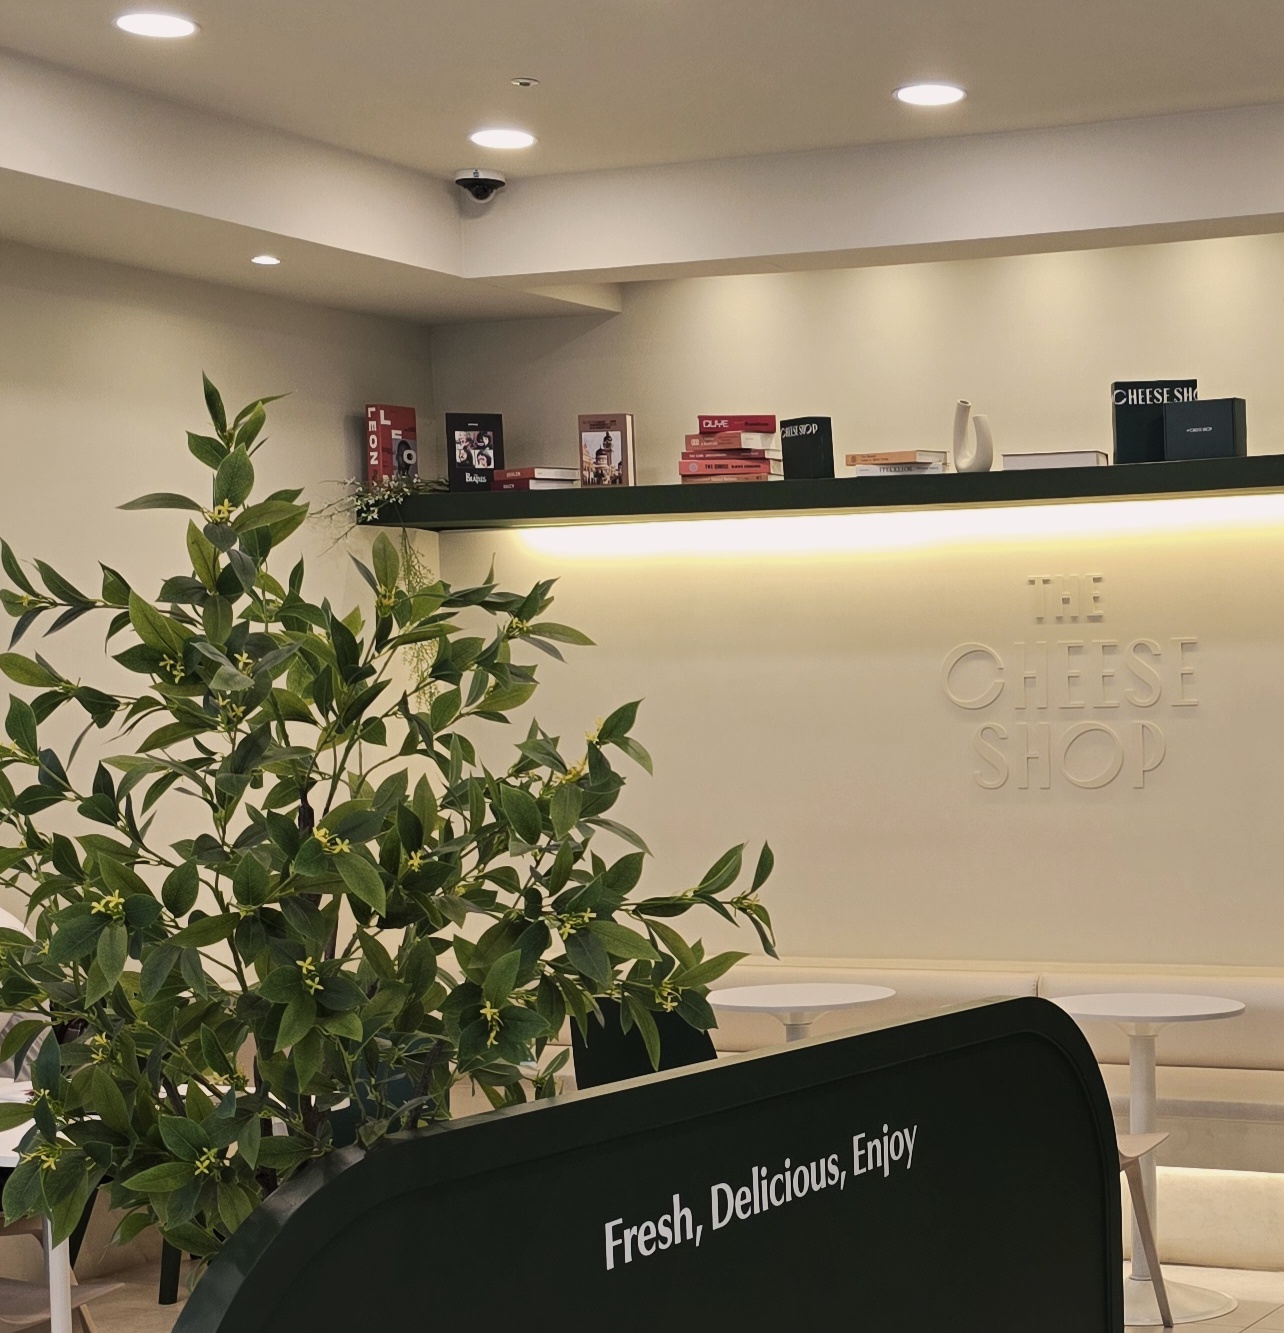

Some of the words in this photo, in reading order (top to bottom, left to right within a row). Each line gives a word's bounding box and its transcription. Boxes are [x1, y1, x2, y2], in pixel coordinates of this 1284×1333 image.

[1112, 387, 1170, 405] CHEESE
[1174, 387, 1198, 402] SH
[1027, 573, 1104, 621] THE
[941, 637, 1199, 711] CHEESE
[973, 721, 1167, 790] SHOP
[605, 1193, 703, 1271] Fresh,
[710, 1154, 847, 1231] Delicious,
[852, 1123, 918, 1178] Enjoy
